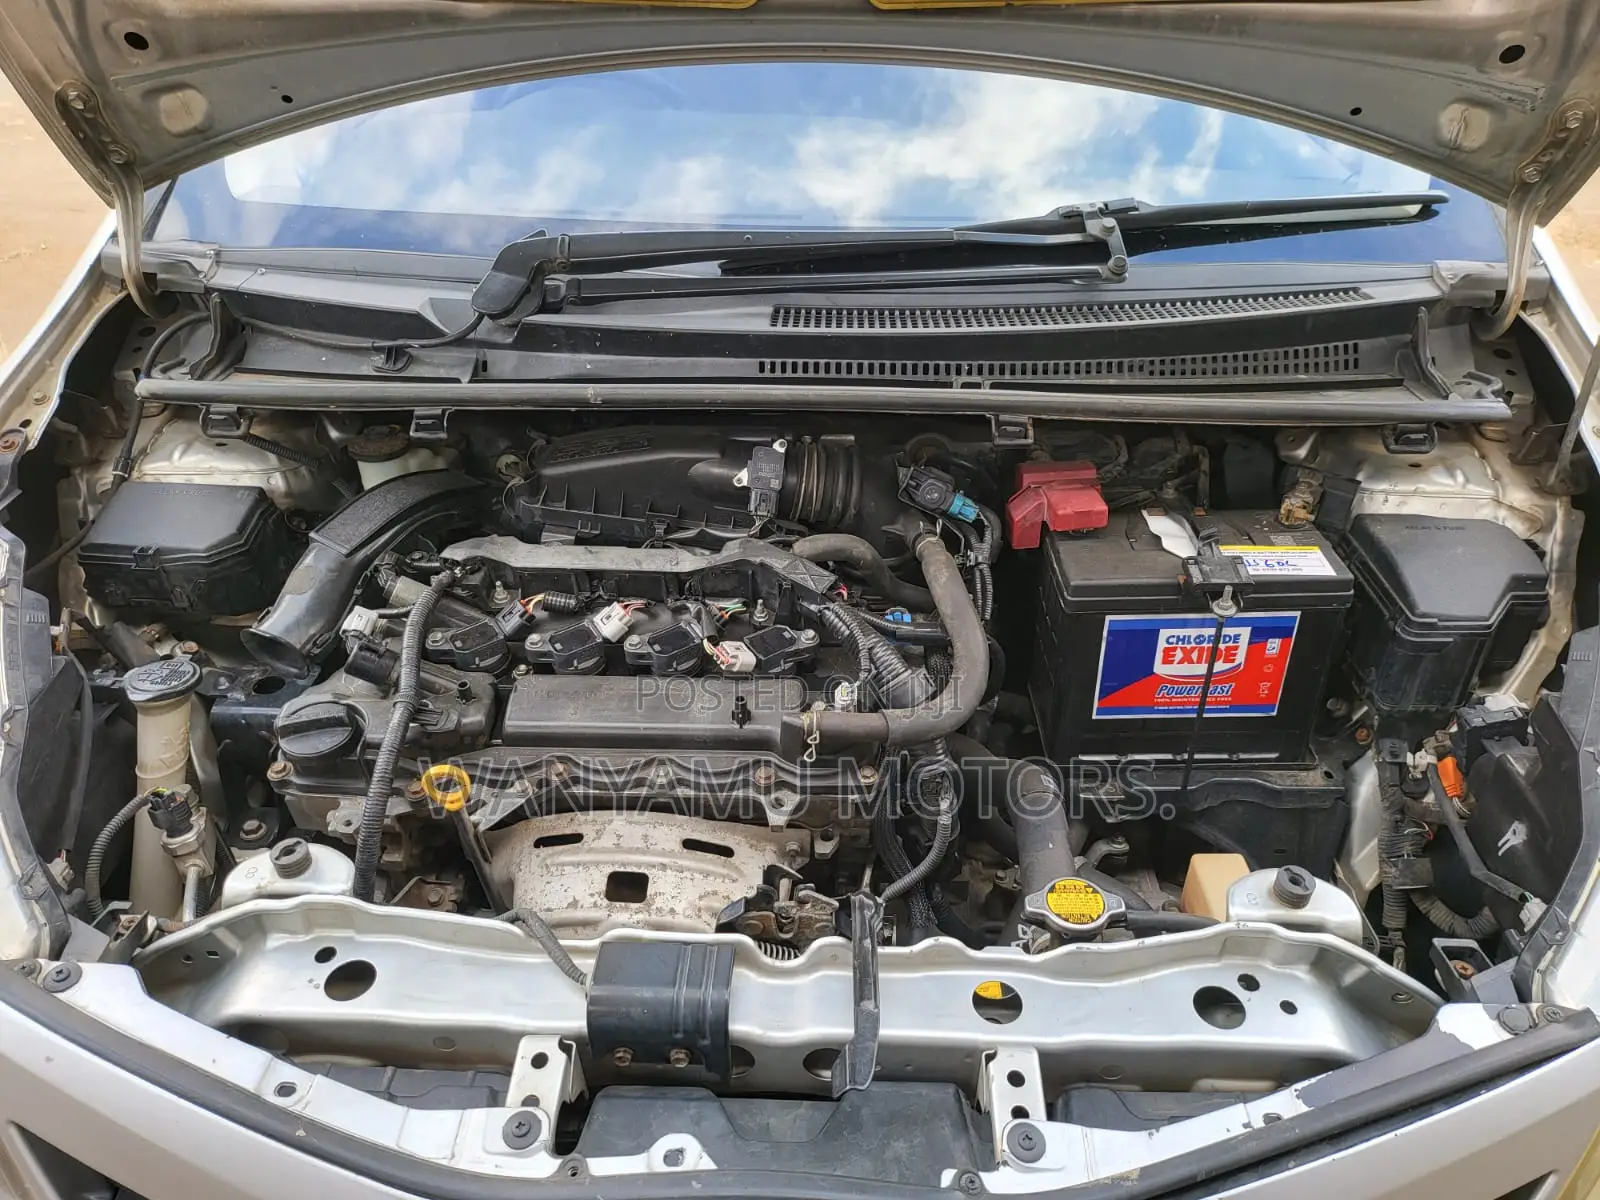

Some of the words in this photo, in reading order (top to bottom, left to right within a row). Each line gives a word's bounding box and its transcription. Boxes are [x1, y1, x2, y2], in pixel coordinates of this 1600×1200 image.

[1165, 634, 1241, 645] CHLORDE
[1161, 645, 1240, 665] EXIDE
[1155, 683, 1235, 697] Powerast
